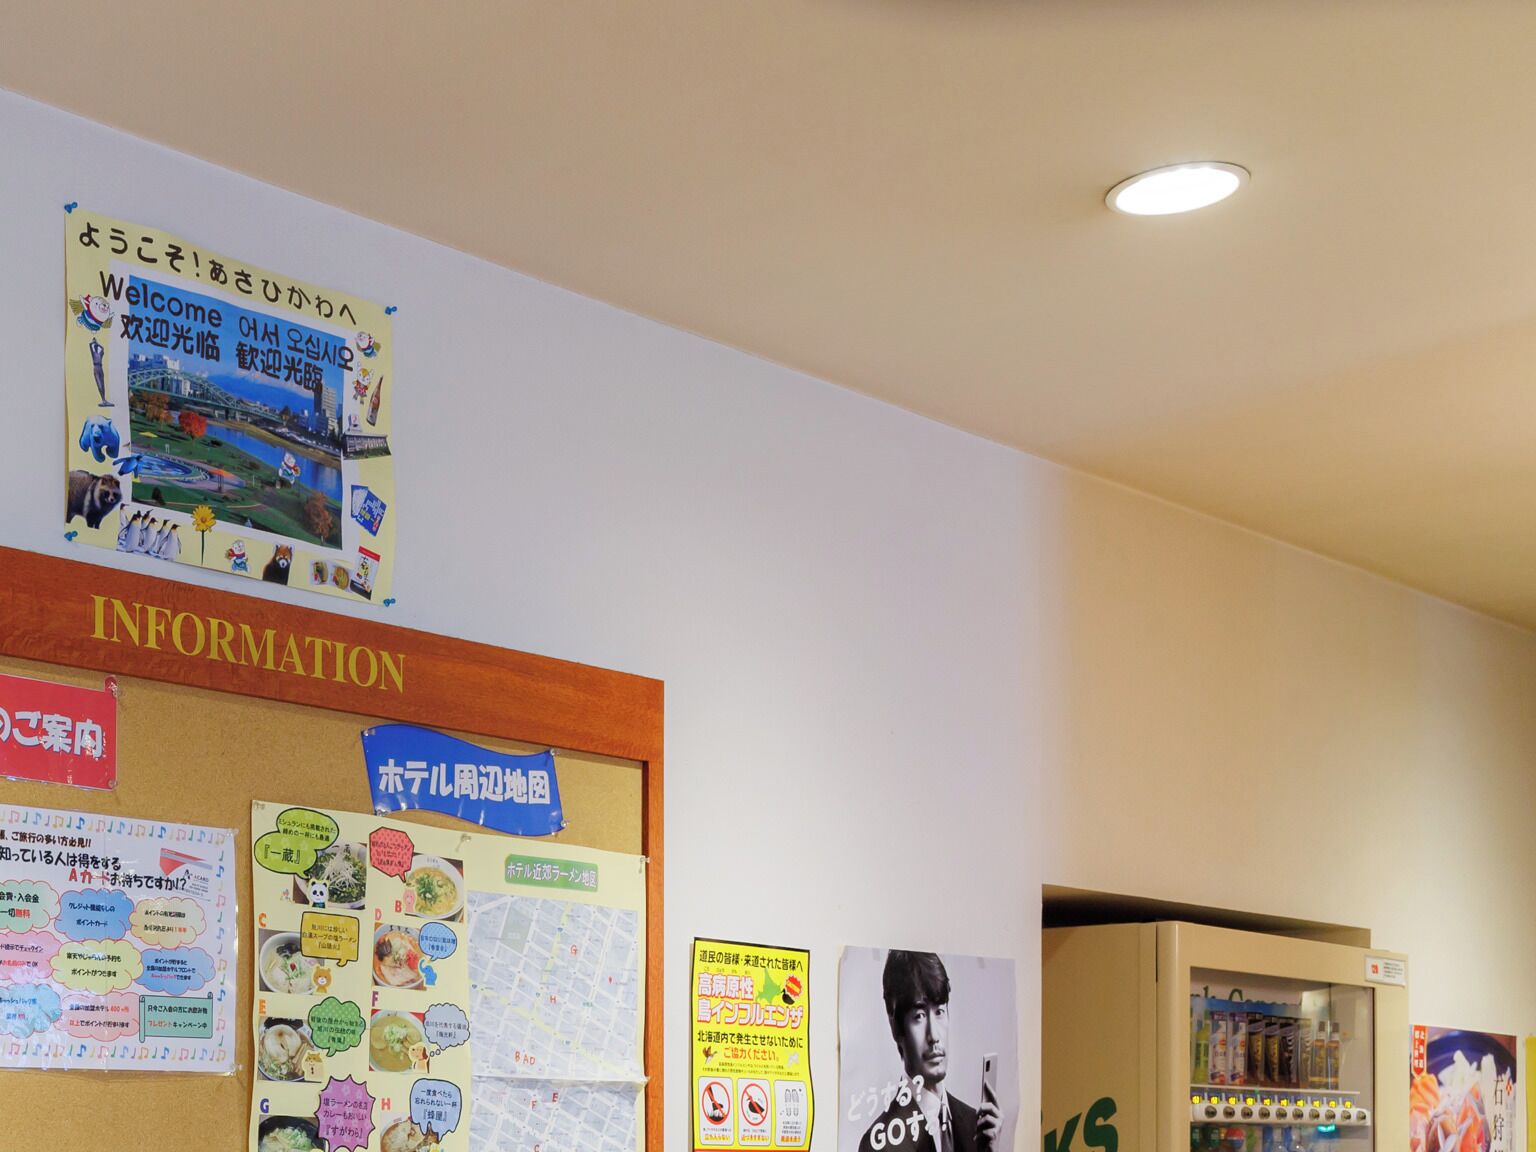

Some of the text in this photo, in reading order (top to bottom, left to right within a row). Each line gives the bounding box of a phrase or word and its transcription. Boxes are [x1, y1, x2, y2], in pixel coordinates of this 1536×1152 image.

[100, 271, 223, 328] Welcome
[120, 313, 220, 362] 欢迎光临
[239, 315, 354, 372] 어서 오십시오
[90, 594, 406, 693] INFORMATION
[378, 759, 550, 805] ホテル周辺地図
[375, 909, 381, 920] D
[395, 900, 401, 912] B
[259, 913, 267, 927] C
[698, 972, 754, 1000] 高病原性
[372, 992, 378, 1006] F
[697, 999, 803, 1029] 鳥インフルエンザ
[698, 1030, 803, 1048] 北海道内で発生させないために
[260, 1099, 269, 1113] G
[381, 1099, 390, 1110] H
